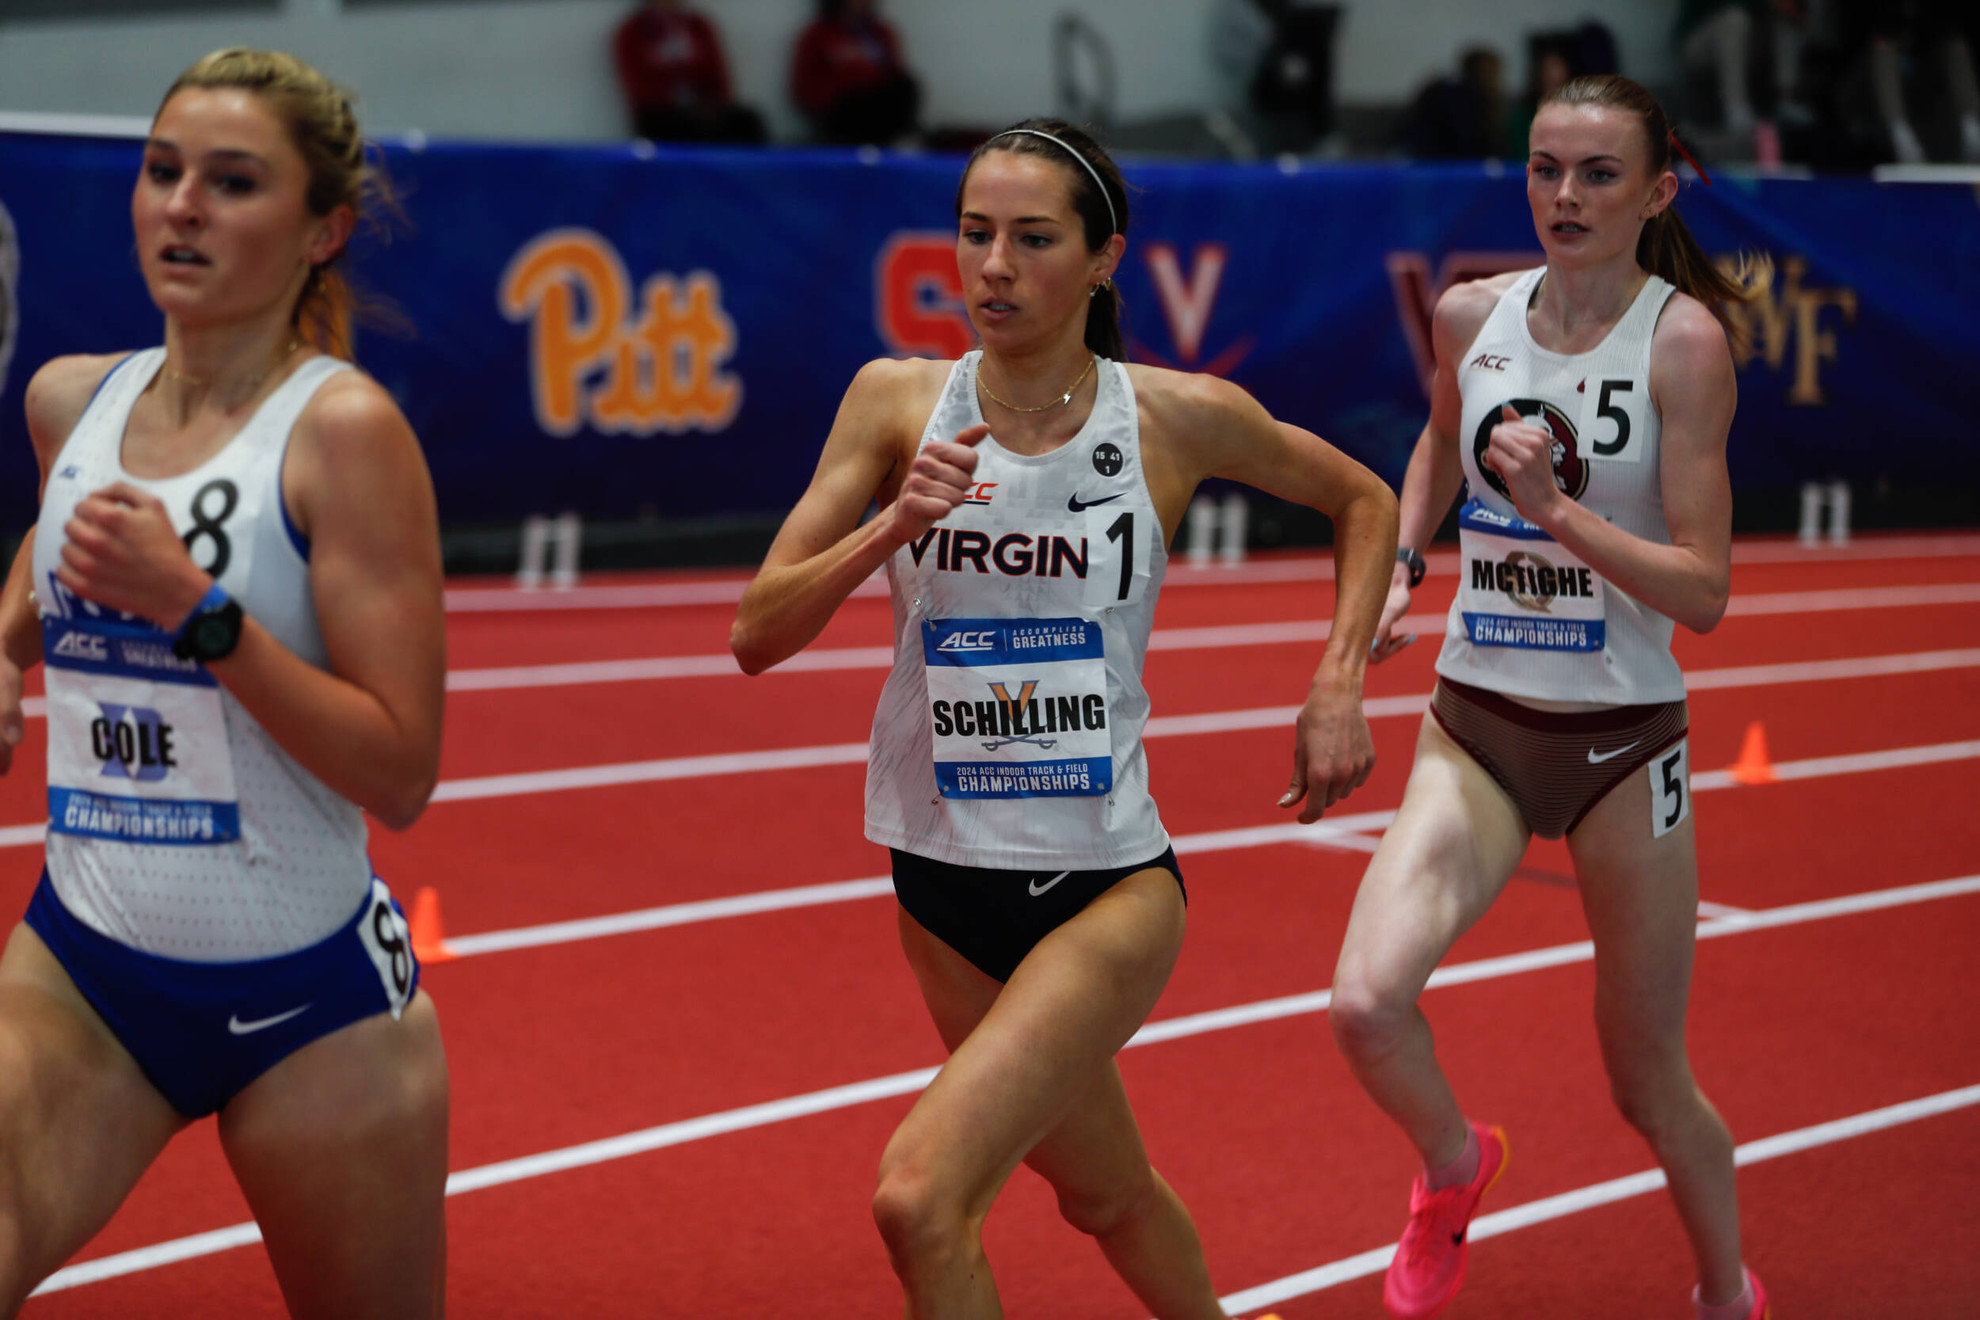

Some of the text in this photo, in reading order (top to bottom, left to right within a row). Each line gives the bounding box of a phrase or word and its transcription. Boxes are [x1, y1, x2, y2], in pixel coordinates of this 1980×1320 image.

[500, 228, 742, 435] Pitt
[1470, 353, 1513, 371] ACC
[1592, 380, 1633, 456] 5
[1095, 451, 1120, 461] 15 41
[1105, 465, 1110, 474] 1
[184, 478, 239, 579] 8
[1105, 512, 1134, 601] 1
[1472, 558, 1593, 598] MCTIGHE
[54, 631, 107, 659] ACC
[939, 631, 1086, 649] ACC GREATNESS
[1013, 625, 1084, 636] ACCOMPLISH
[1475, 626, 1587, 647] CHAMPIONSHIPS
[932, 694, 1106, 737] SCHILLING
[91, 717, 178, 767] COLE
[957, 763, 1088, 776] 2024 ACC INDOOR TRACK & FIELD
[958, 774, 1091, 792] CHAMPIONSHIPS
[1662, 748, 1682, 829] 5
[64, 805, 214, 840] CHAMPIONSHIPS
[373, 901, 409, 995] 8
